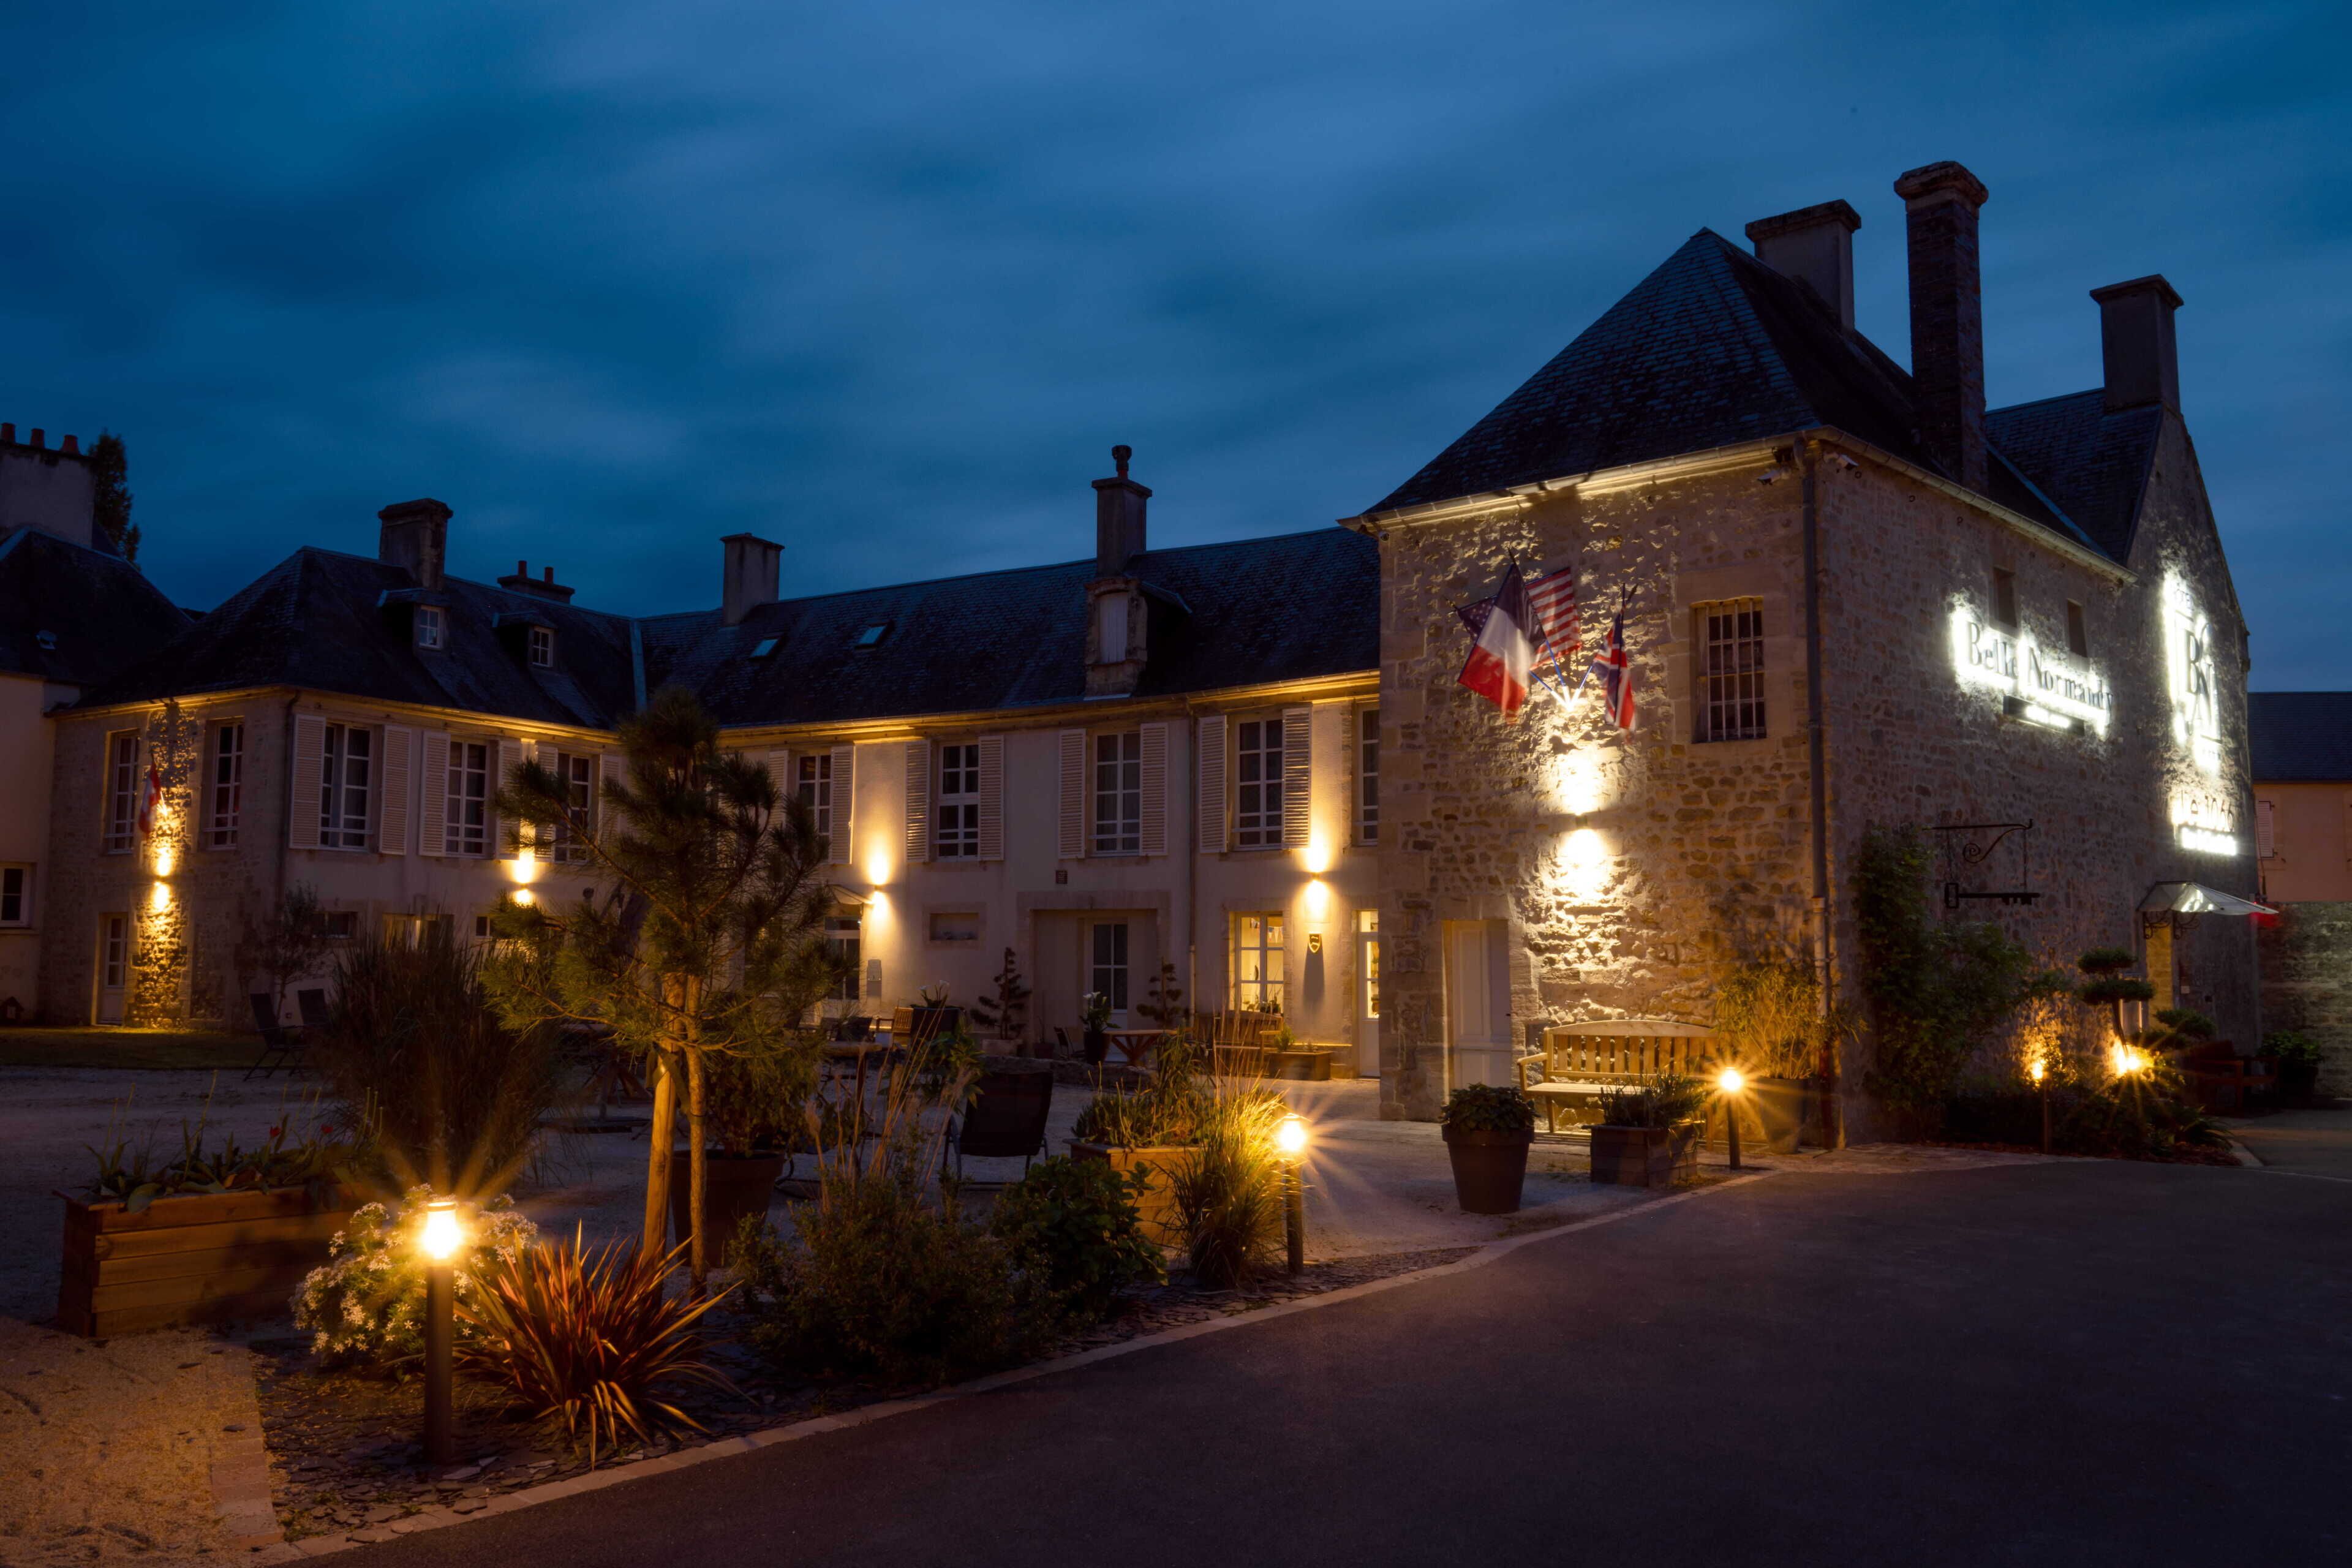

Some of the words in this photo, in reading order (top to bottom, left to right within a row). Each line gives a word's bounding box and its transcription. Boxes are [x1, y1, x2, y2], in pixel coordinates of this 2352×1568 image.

[1966, 620, 2019, 679] Belle
[2027, 646, 2113, 725] Normandy
[2205, 795, 2236, 832] 1066
